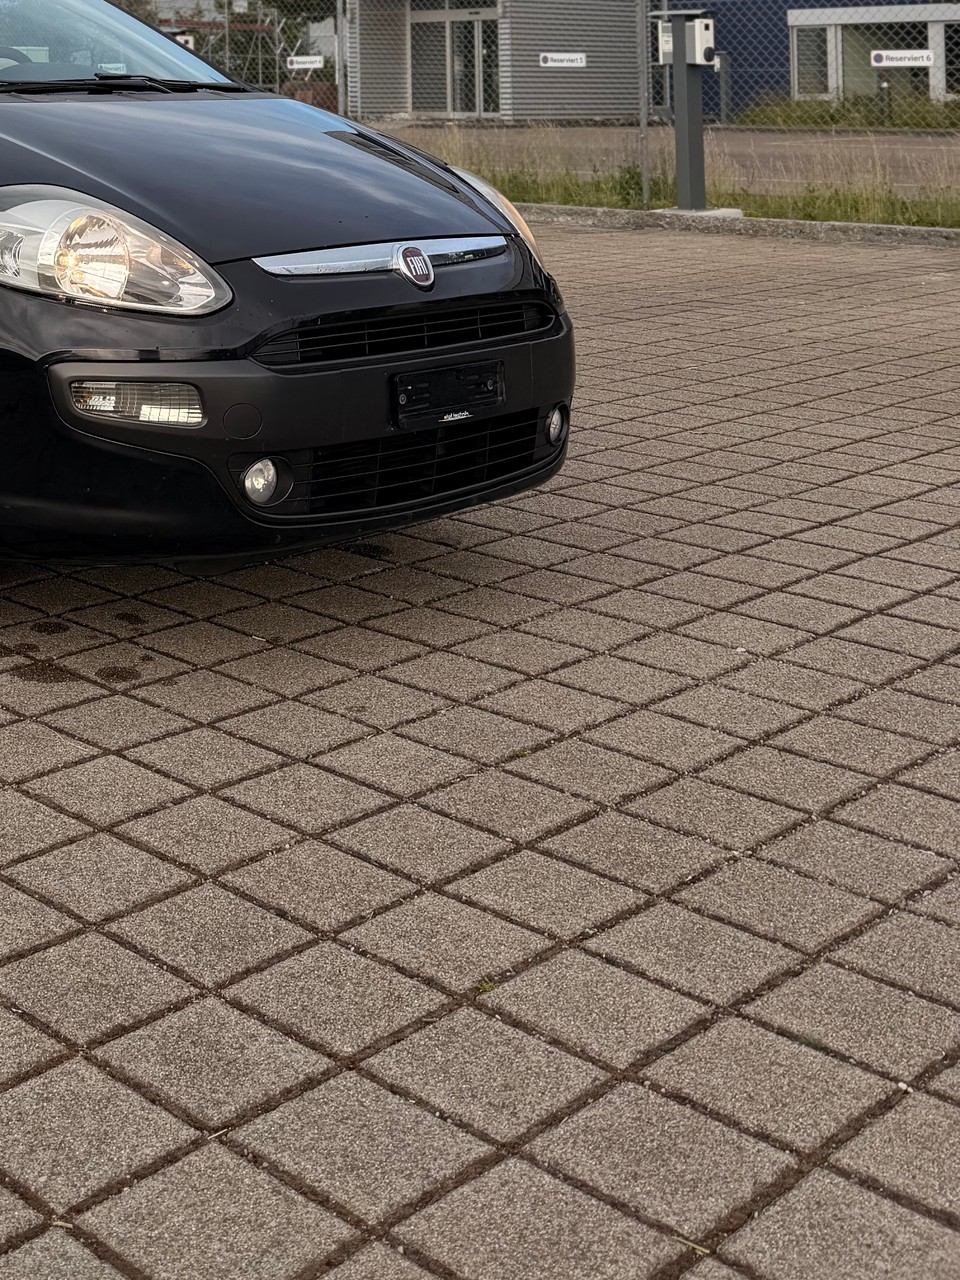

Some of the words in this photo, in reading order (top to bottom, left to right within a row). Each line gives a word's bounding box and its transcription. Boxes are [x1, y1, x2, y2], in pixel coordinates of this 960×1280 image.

[550, 56, 579, 64] Reserviert
[885, 54, 925, 62] Reserviert
[926, 54, 932, 62] 6
[406, 256, 428, 276] FIAT
